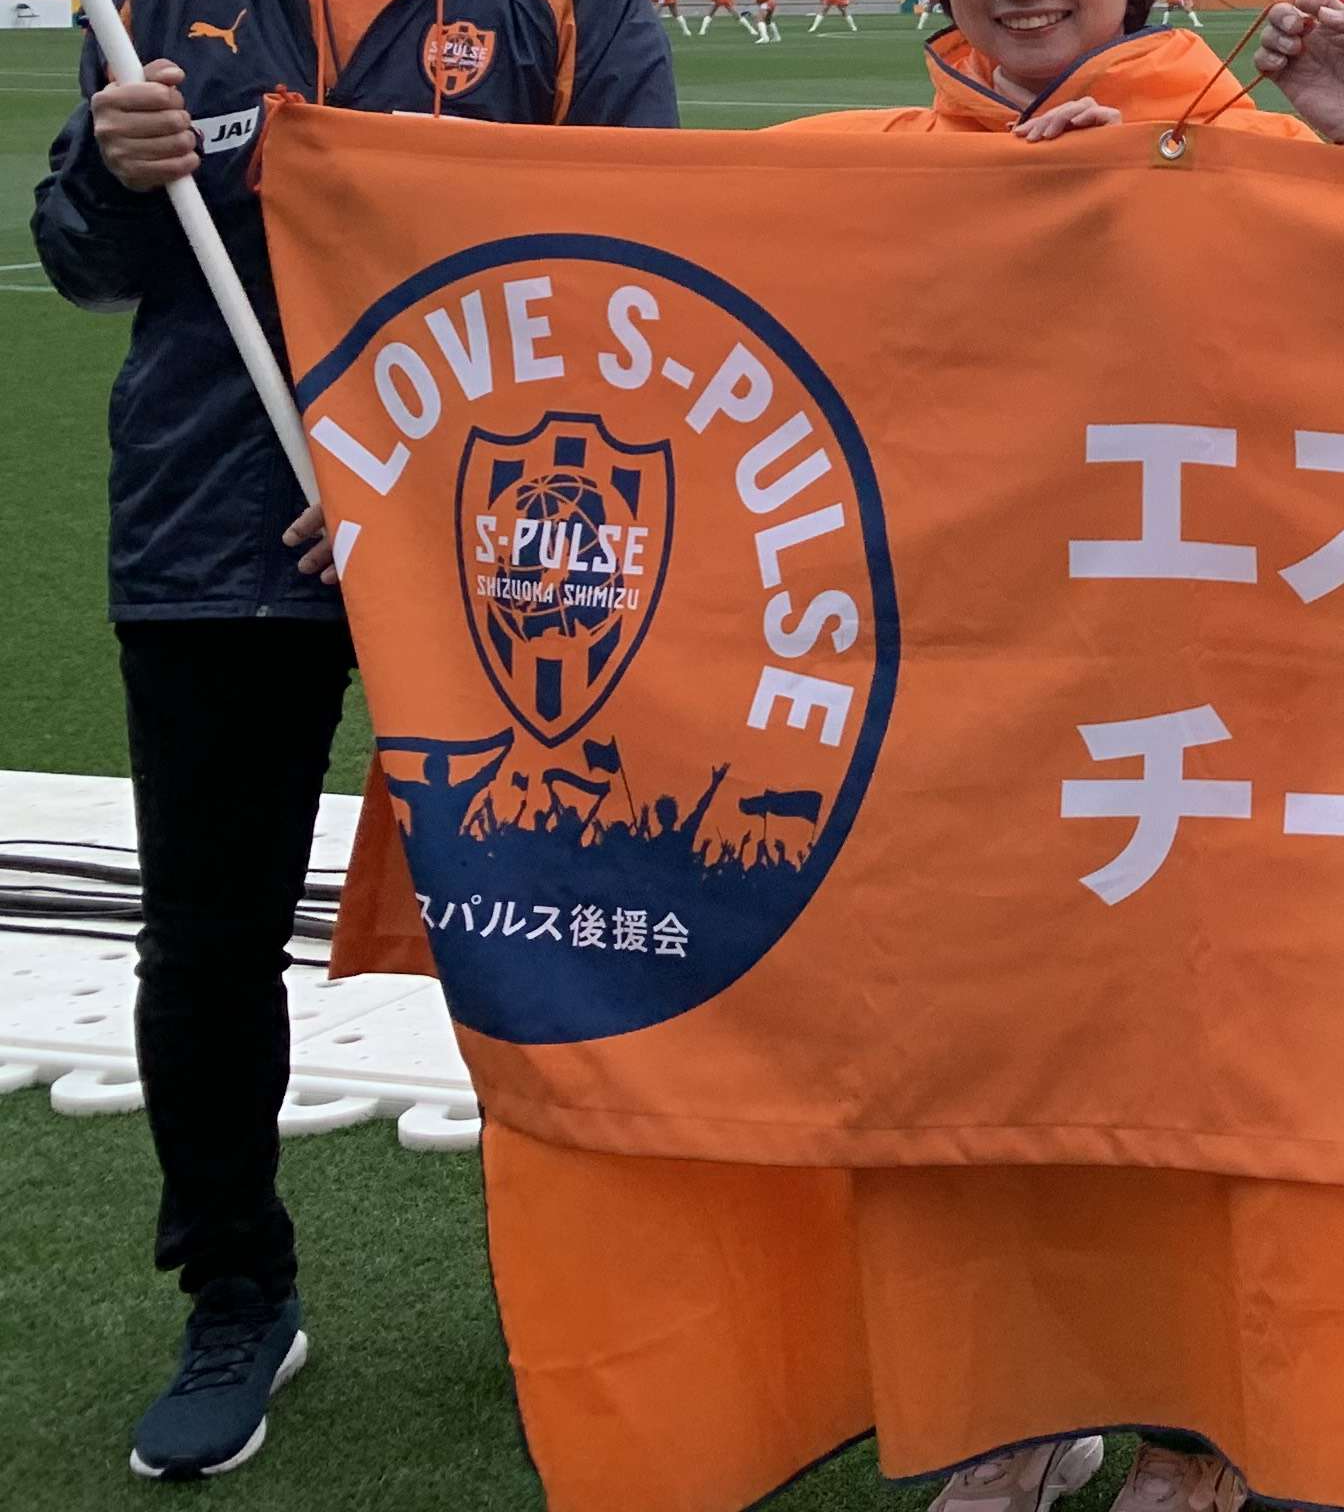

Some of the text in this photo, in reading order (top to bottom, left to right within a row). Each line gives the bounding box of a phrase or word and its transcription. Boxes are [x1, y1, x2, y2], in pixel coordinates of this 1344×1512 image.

[428, 40, 489, 62] SPULSE
[210, 118, 253, 143] JAL
[309, 274, 861, 749] LOVE S-PULSE
[475, 513, 649, 576] S-PULSE
[476, 575, 640, 611] SHIZUOKA SHIMIZU
